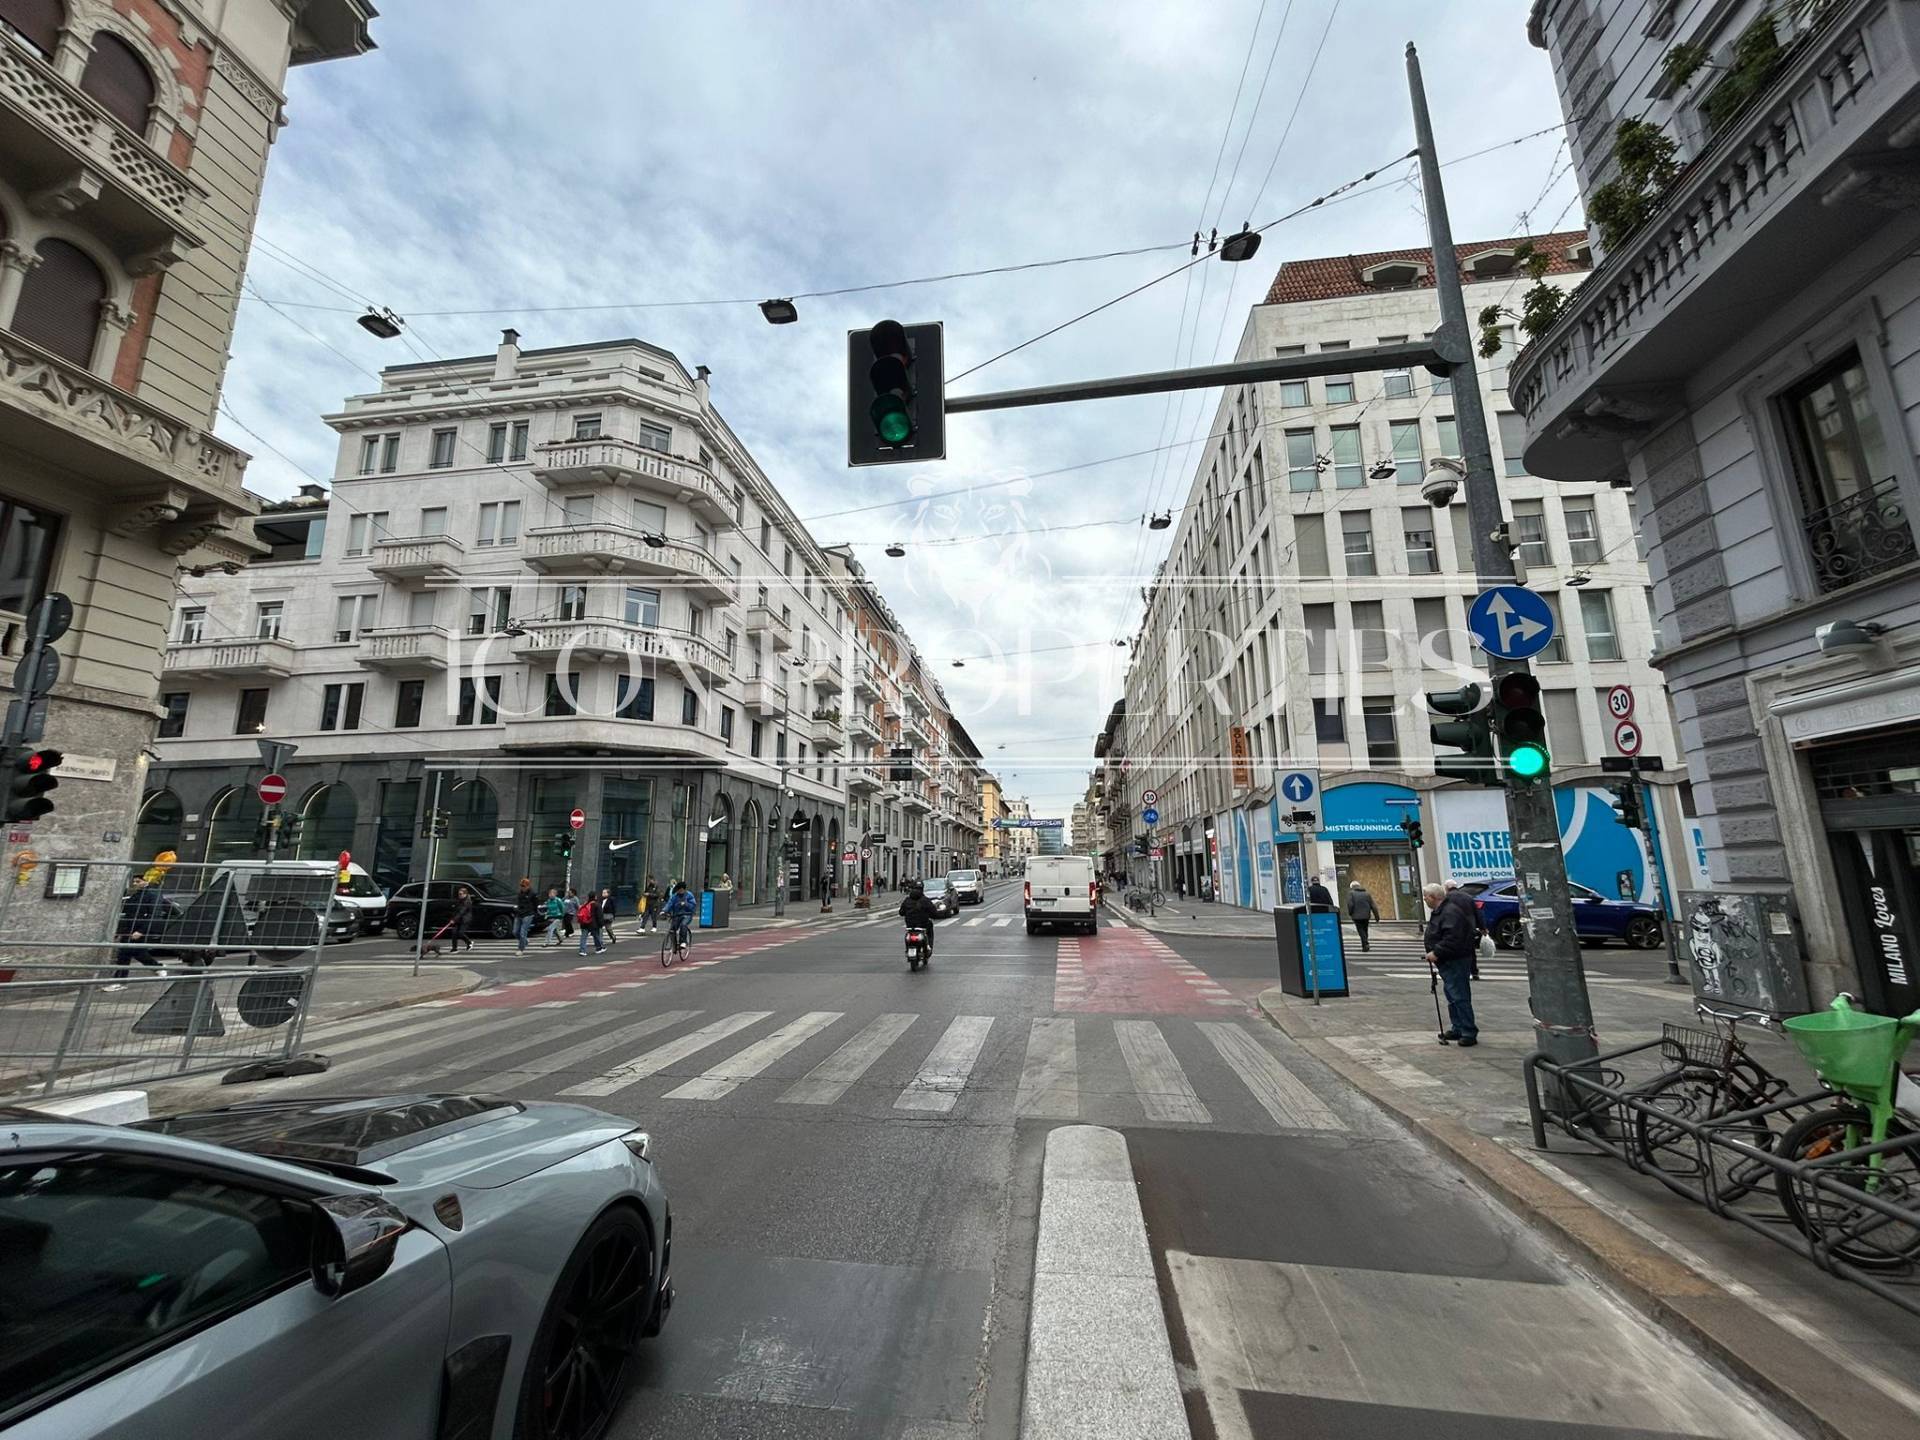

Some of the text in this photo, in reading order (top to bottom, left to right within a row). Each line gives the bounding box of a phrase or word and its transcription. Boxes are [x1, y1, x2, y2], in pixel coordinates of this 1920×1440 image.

[1612, 693, 1628, 712] 30
[1146, 793, 1155, 801] 30
[1325, 824, 1404, 832] MISTERRUNNING.C
[1449, 851, 1514, 869] RUNNIN
[1870, 886, 1909, 985] MILANO Loves
